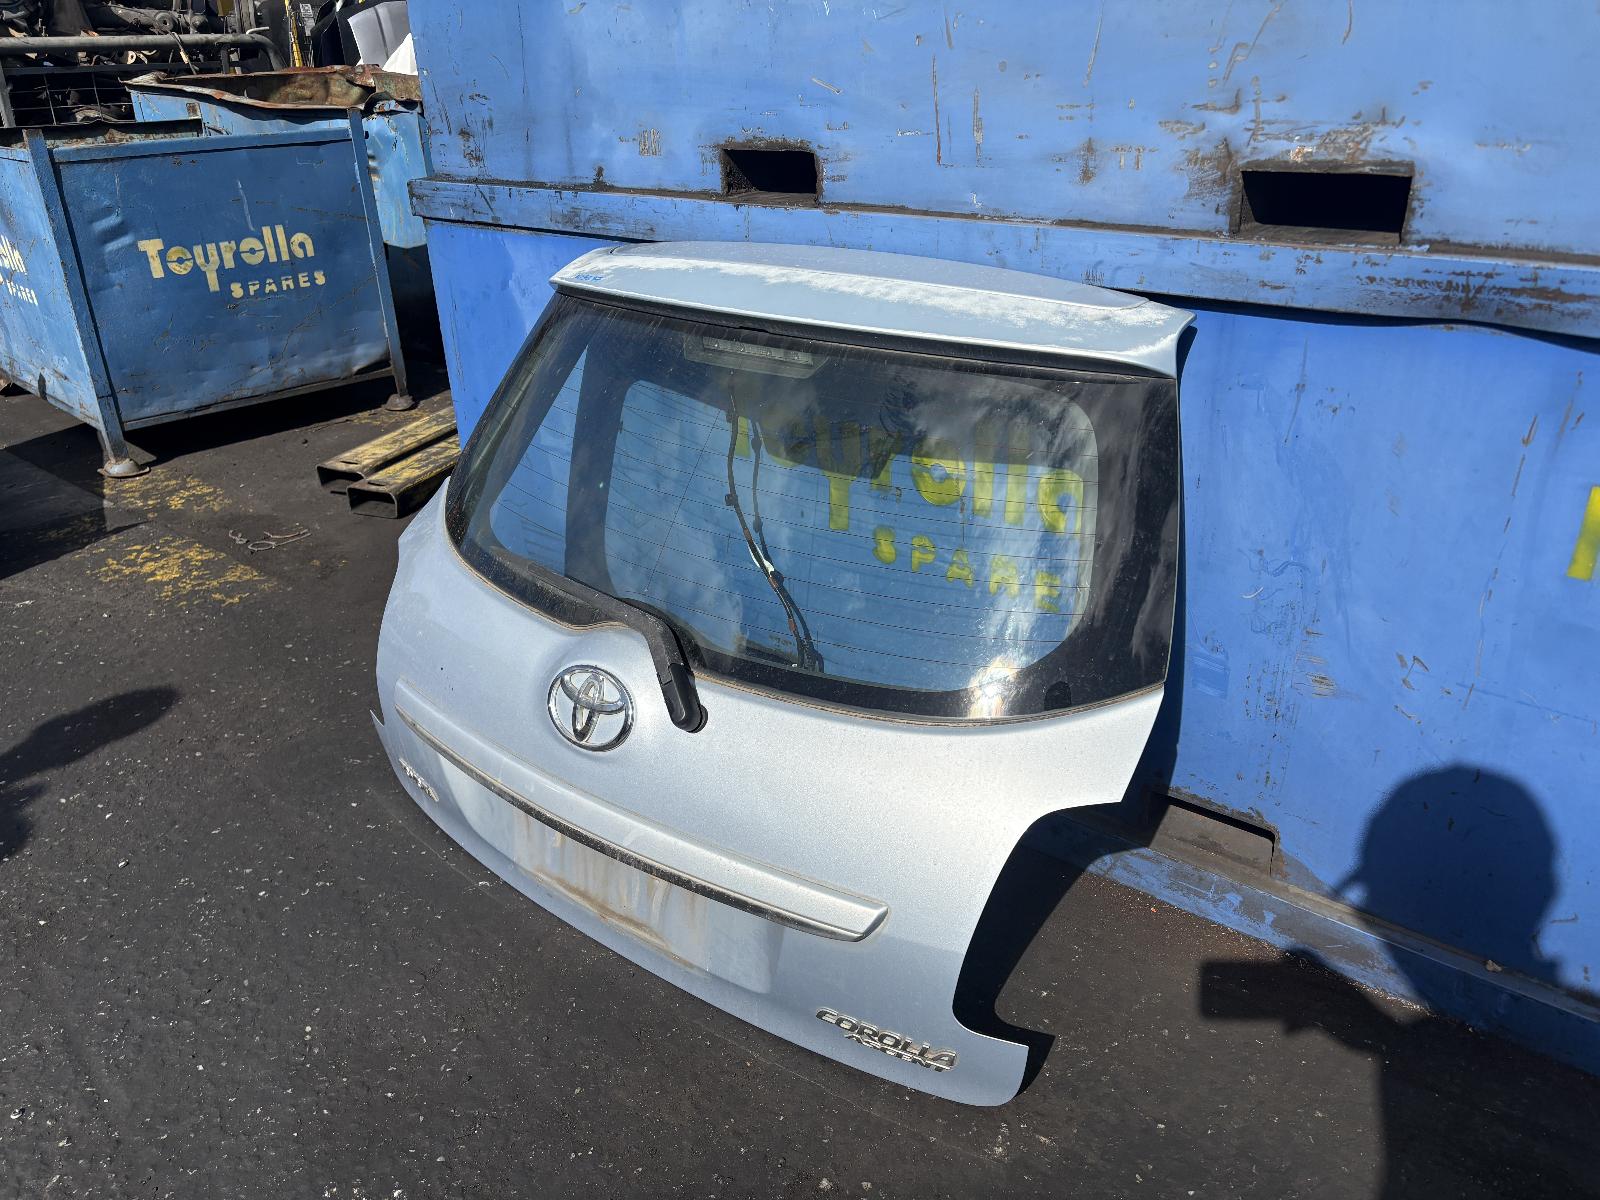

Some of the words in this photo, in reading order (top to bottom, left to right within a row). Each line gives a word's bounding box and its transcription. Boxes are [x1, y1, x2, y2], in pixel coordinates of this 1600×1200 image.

[137, 224, 315, 292] Toyrolla
[230, 269, 326, 299] SPARES
[815, 1006, 958, 1071] COROLLA
